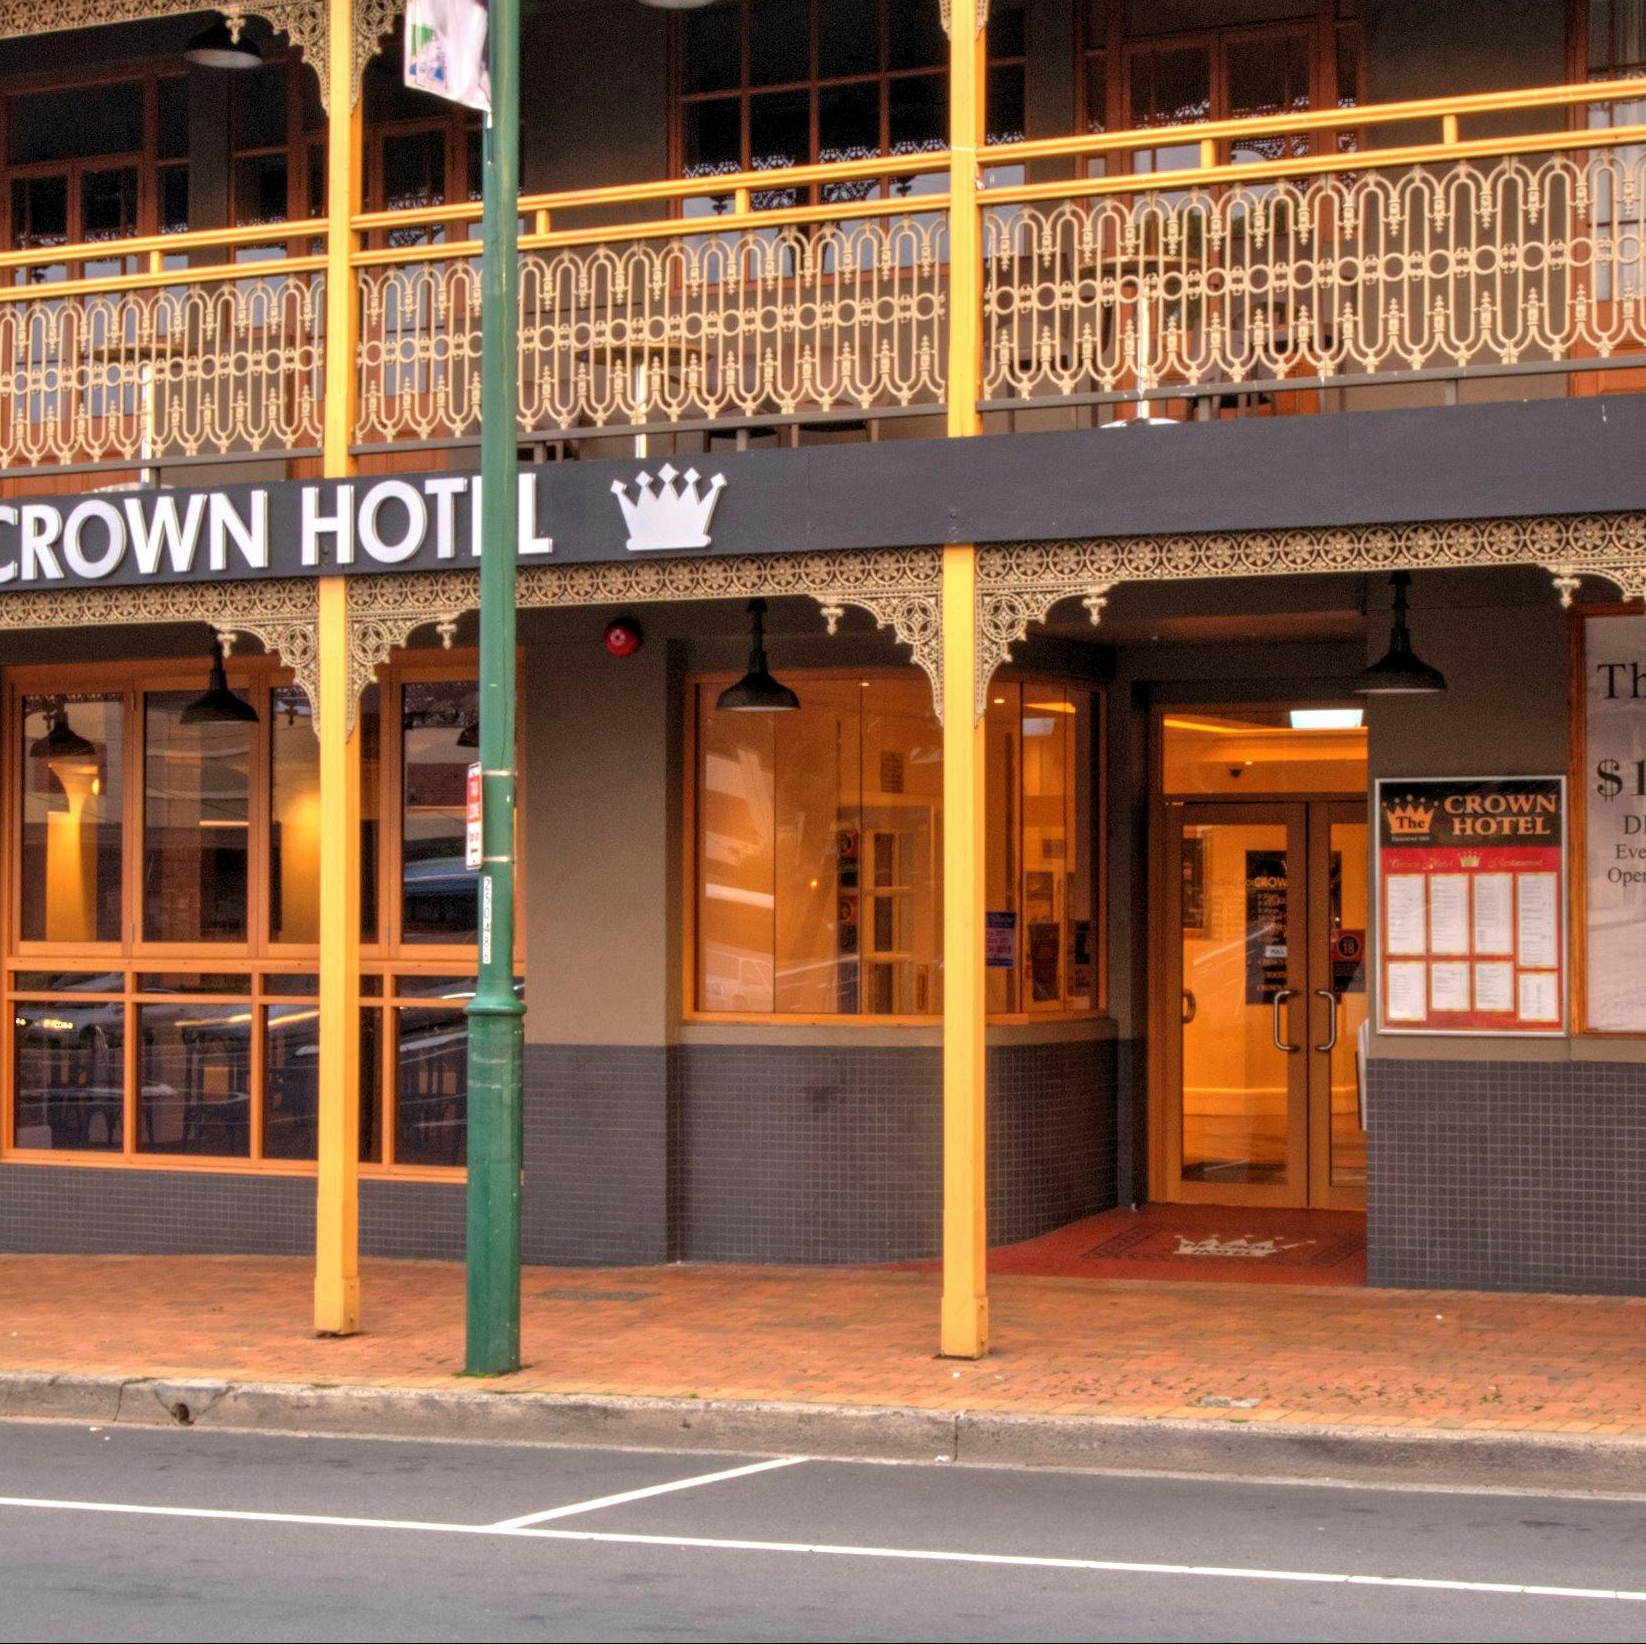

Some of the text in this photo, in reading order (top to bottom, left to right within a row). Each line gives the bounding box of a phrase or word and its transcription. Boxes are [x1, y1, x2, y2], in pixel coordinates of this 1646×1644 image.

[301, 472, 554, 566] HOTL
[1443, 795, 1558, 814] CROWN
[1396, 815, 1425, 830] The
[1452, 816, 1552, 835] HOTEL
